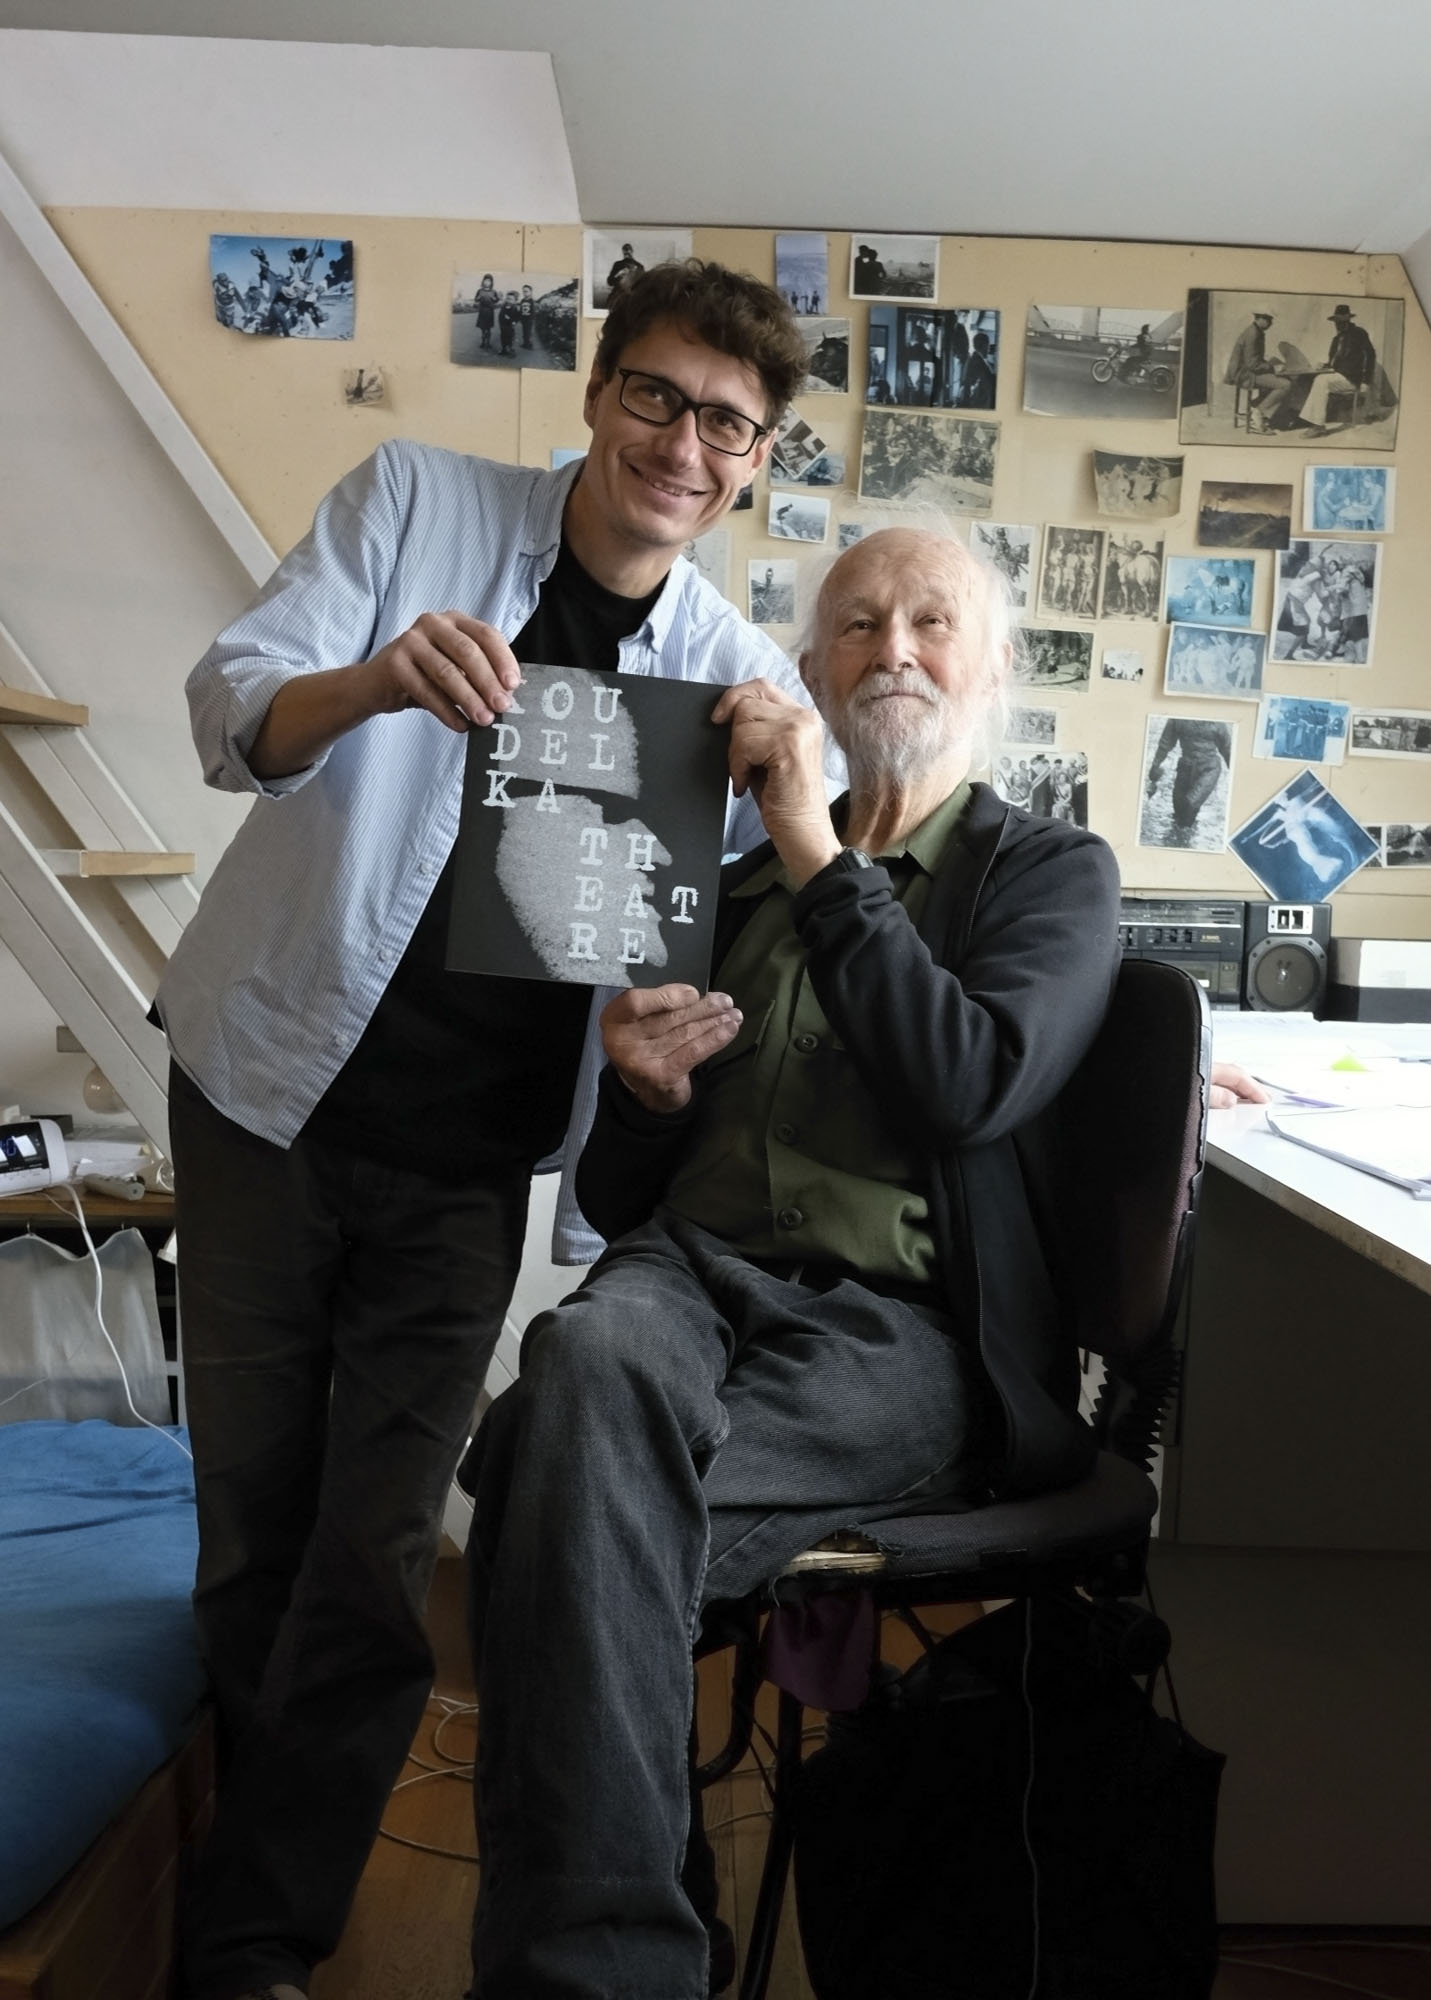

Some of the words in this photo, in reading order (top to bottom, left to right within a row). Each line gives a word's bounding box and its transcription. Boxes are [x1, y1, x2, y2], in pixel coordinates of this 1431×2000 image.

[489, 723, 615, 771] DEL
[482, 770, 561, 813] KA
[579, 827, 658, 871] TH
[574, 875, 699, 923] EAT
[567, 922, 646, 964] RE
